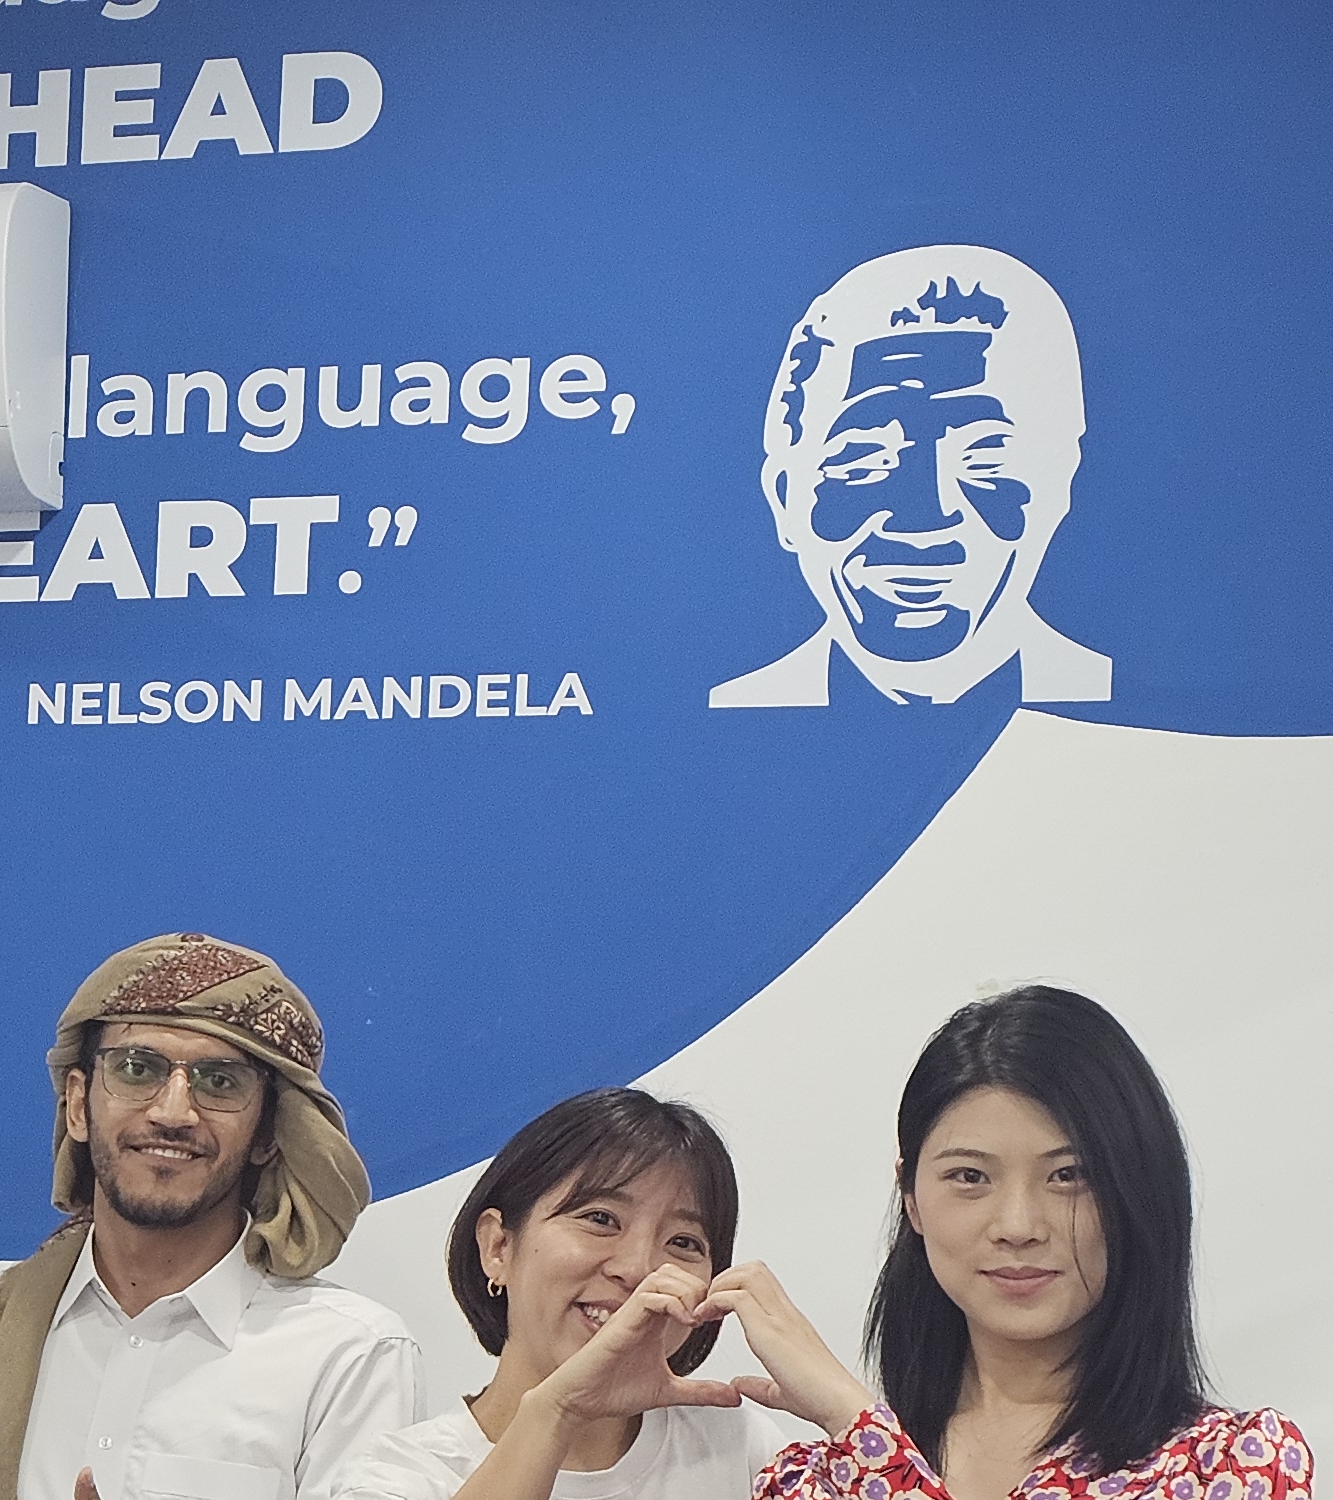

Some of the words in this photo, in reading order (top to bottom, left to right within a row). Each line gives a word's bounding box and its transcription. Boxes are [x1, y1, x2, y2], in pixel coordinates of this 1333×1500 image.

[67, 353, 636, 453] language,
[27, 680, 262, 726] NELSON
[284, 673, 594, 722] MANDELA
